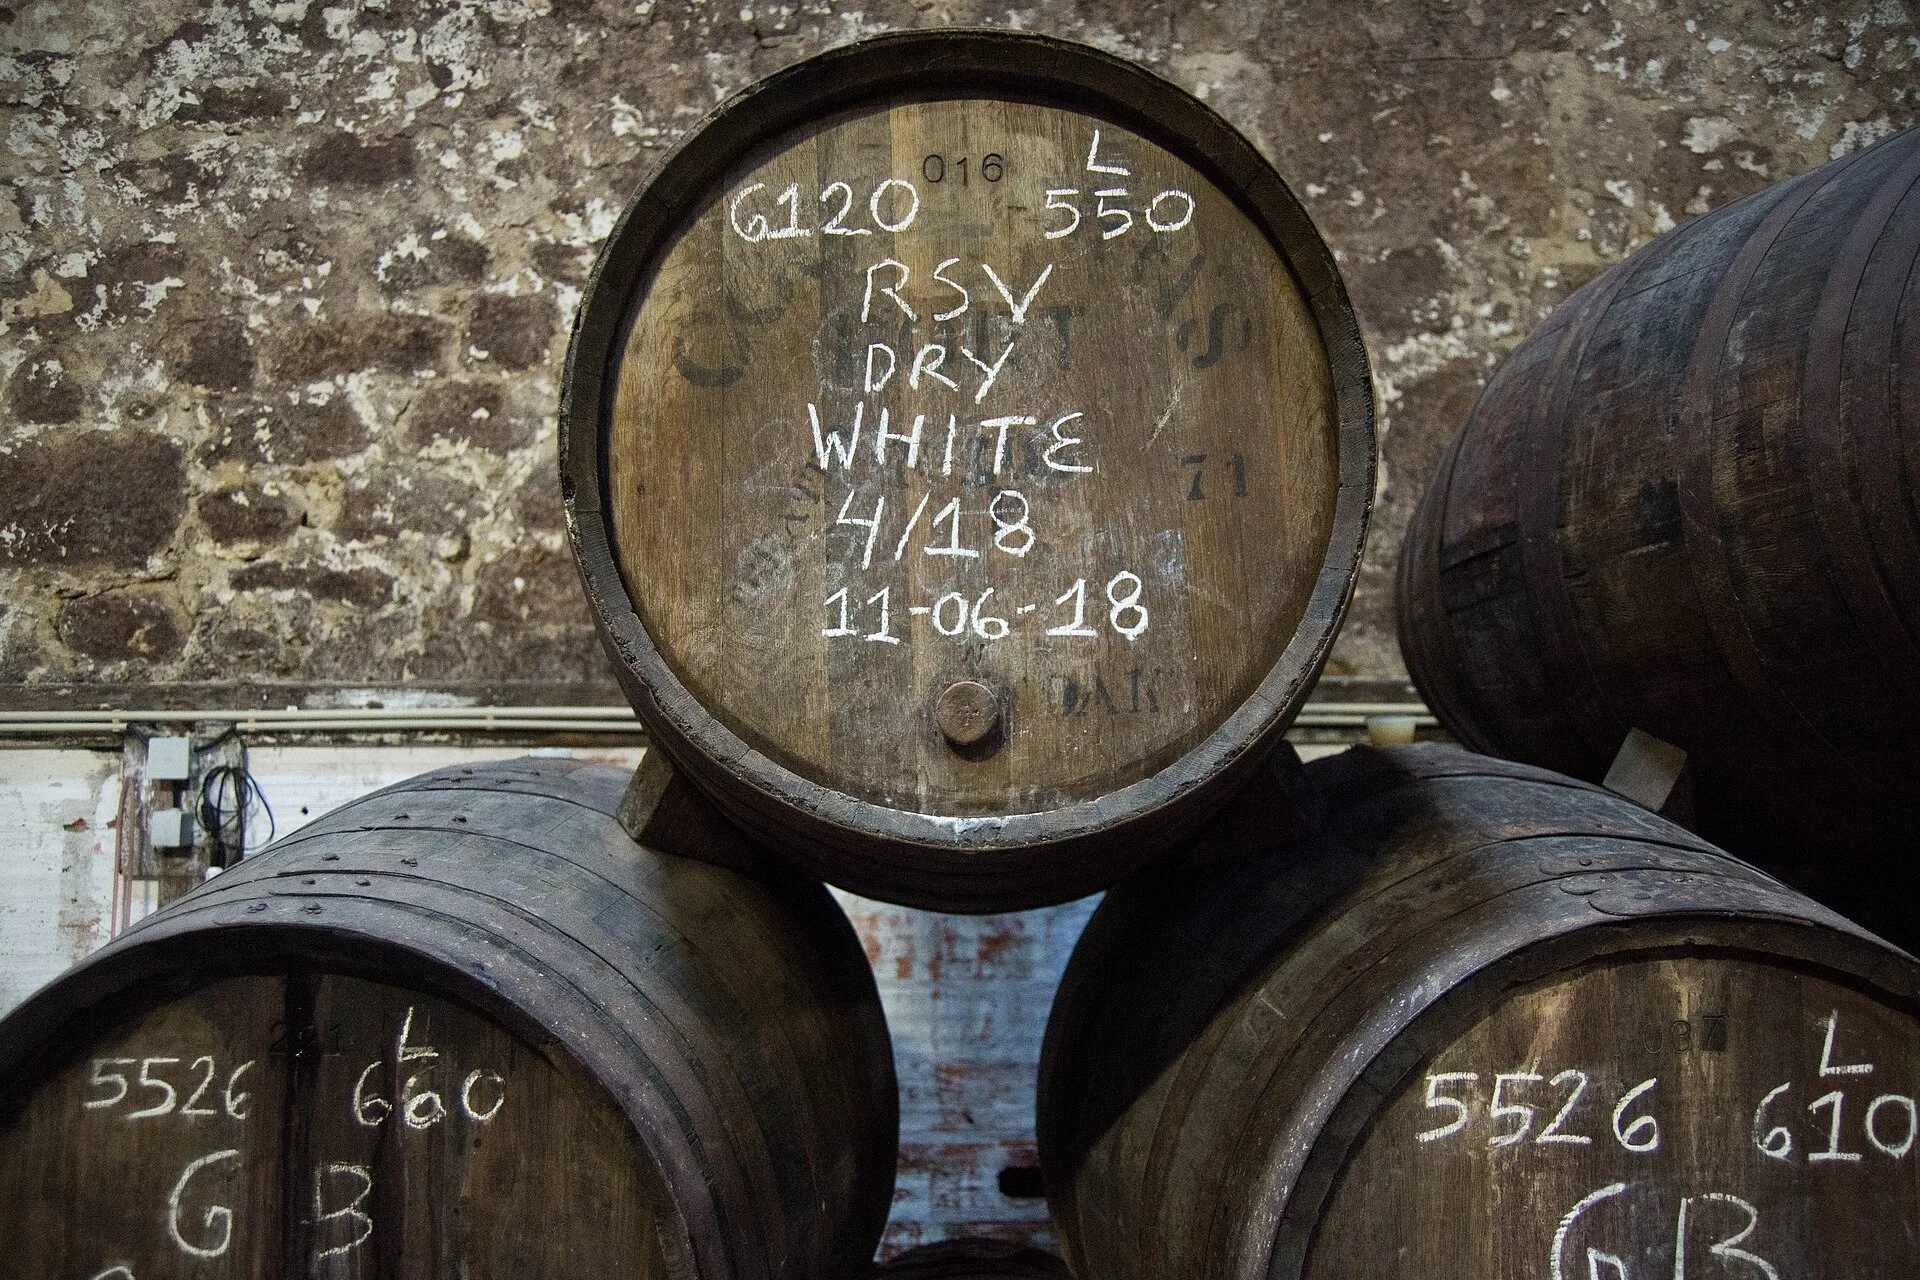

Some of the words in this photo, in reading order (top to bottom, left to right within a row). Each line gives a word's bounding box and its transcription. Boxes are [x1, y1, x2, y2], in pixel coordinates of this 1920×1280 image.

[922, 151, 1005, 187] 016
[1086, 129, 1130, 176] L
[730, 178, 920, 243] 6120
[1045, 187, 1196, 241] 550
[860, 256, 1053, 325] RSV
[864, 341, 1015, 404] DRY
[806, 401, 1094, 476] WHITE
[835, 489, 1036, 571] 4/18
[821, 570, 1149, 644] 11-06-18
[1818, 1008, 1873, 1077] L
[83, 1055, 256, 1121] 5526
[352, 1060, 506, 1130] 660
[1418, 1068, 1660, 1153] 5526
[1753, 1081, 1918, 1161] 610
